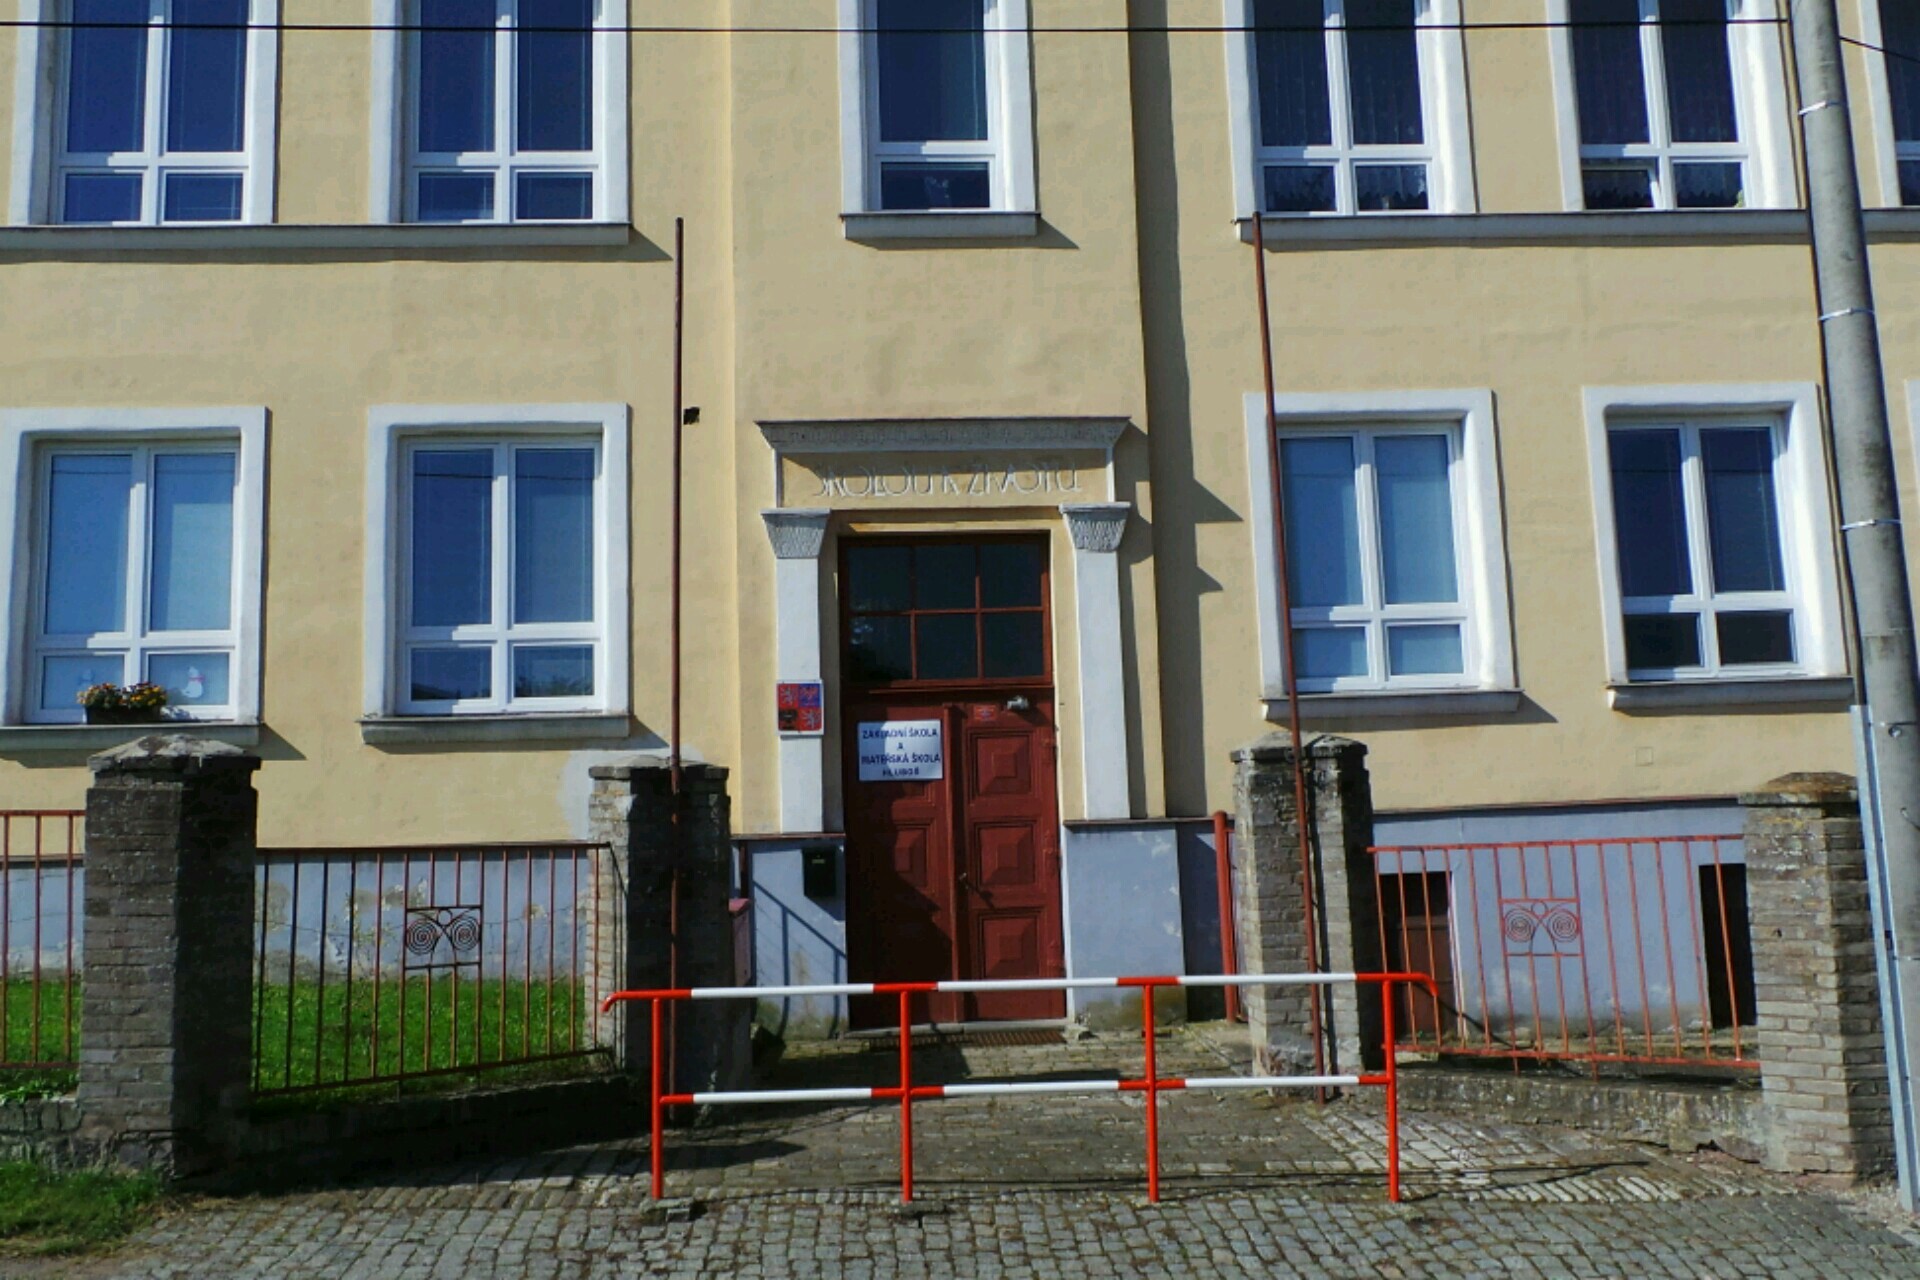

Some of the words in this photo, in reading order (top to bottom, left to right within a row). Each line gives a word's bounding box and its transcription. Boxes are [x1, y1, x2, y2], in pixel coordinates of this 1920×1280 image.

[909, 727, 937, 737] ŠKOLA
[861, 753, 909, 764] MATEŘSKÁ
[912, 752, 940, 763] ŠKOLA
